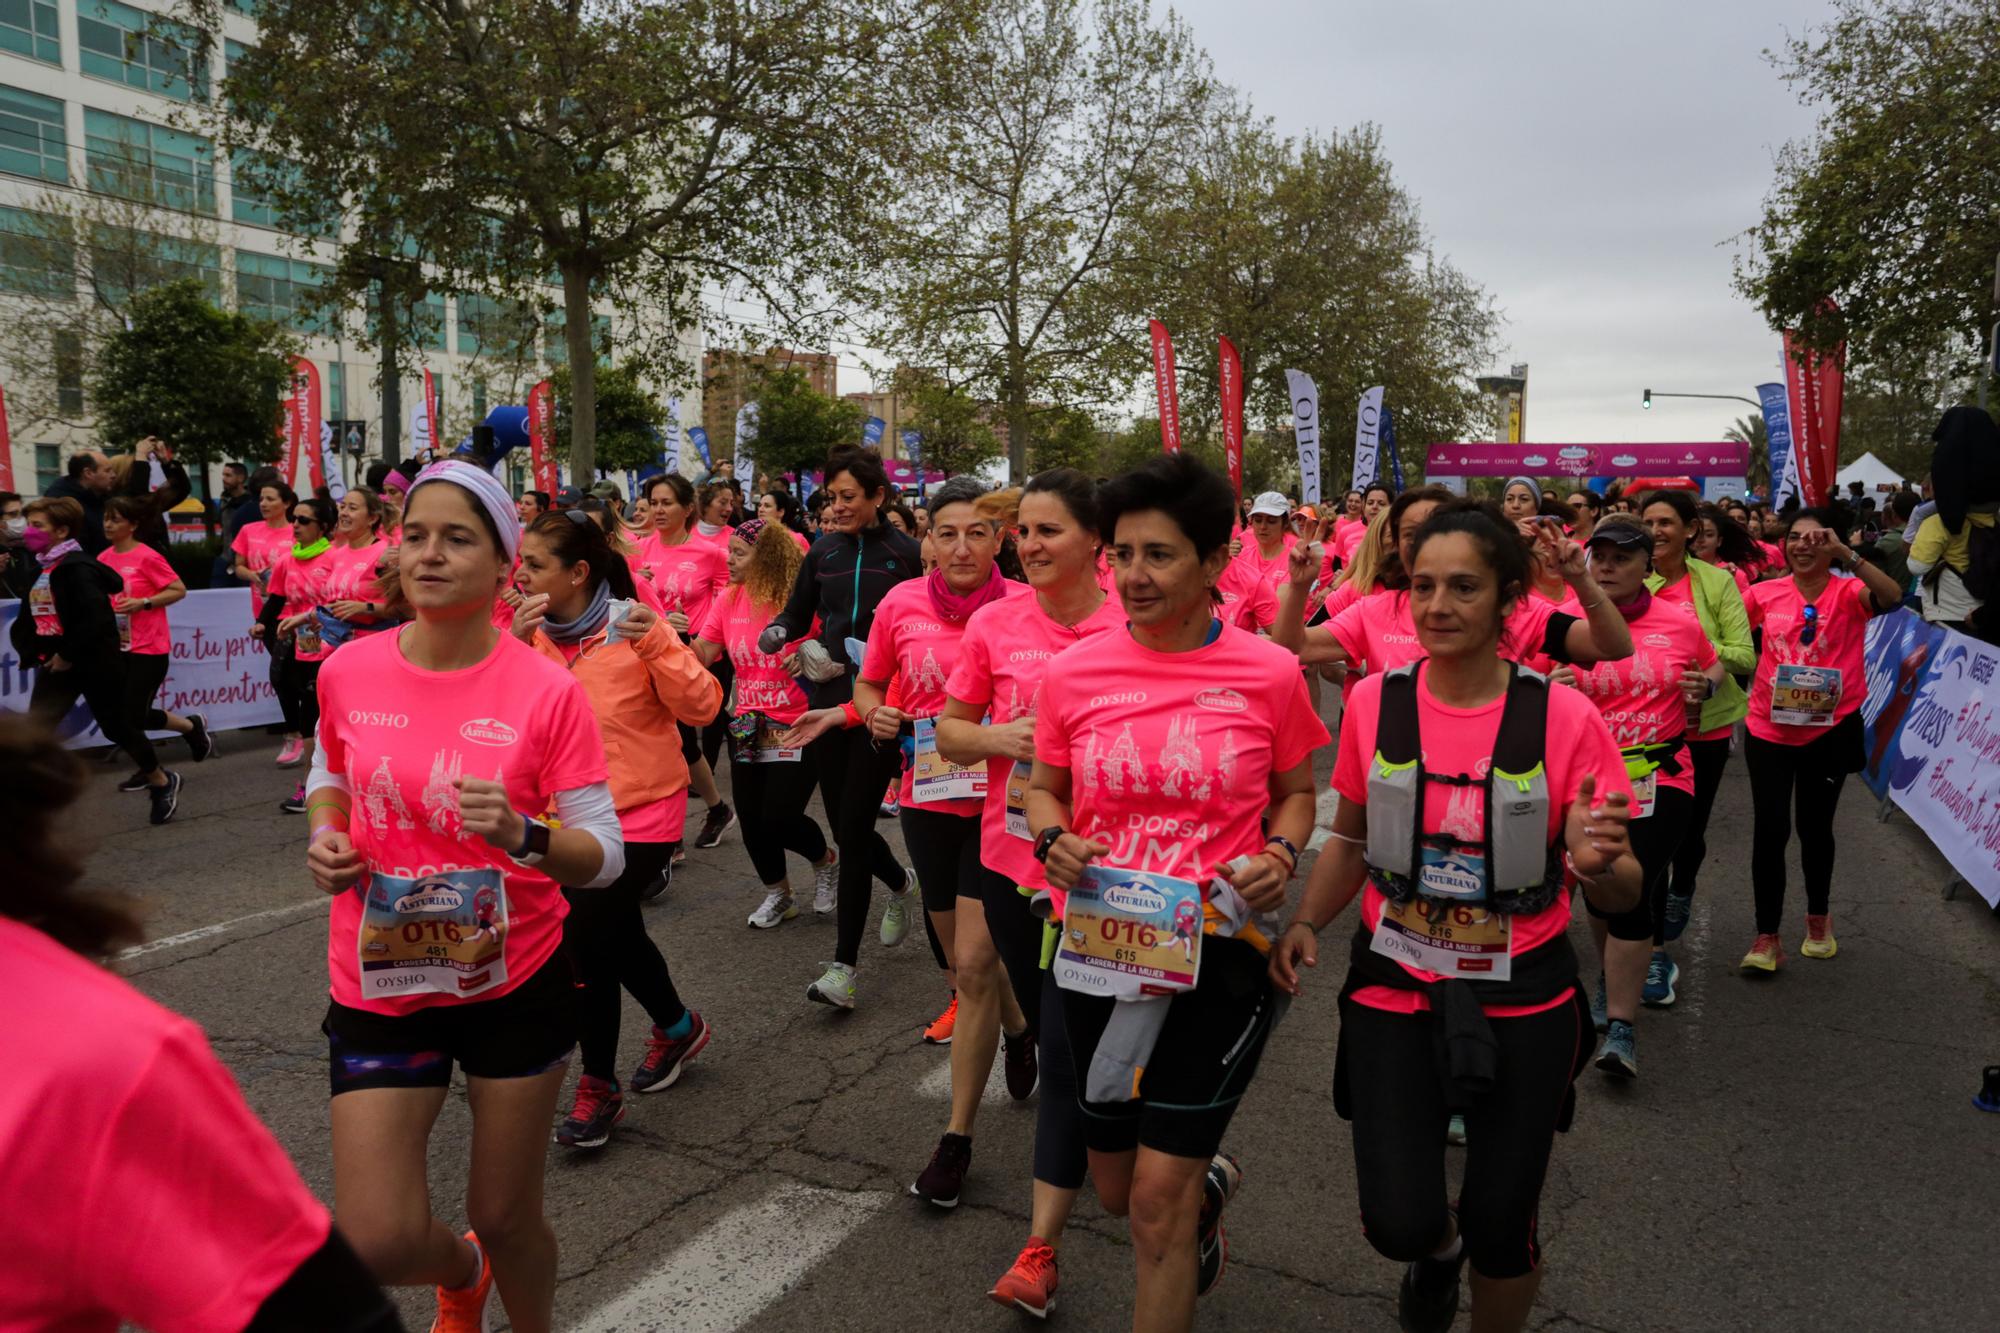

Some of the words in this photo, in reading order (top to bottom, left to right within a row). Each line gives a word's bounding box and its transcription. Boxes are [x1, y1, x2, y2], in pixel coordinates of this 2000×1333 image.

[902, 623, 942, 633] OYSHO
[192, 627, 222, 660] tu
[1010, 650, 1054, 663] OYSHO
[748, 679, 790, 690] DORSAL
[738, 688, 791, 706] SUMA
[1090, 690, 1147, 709] OYSHO
[1791, 688, 1820, 701] 016
[348, 710, 409, 729] OYSHO
[463, 725, 514, 742] ASTURIANA
[920, 786, 948, 797] OYSHO
[1423, 868, 1477, 890] ASTURIANA
[399, 897, 460, 912] ASTURIANA
[1107, 890, 1162, 909] ASTURIANA
[402, 920, 461, 943] 016
[1101, 917, 1157, 949] 016
[1429, 925, 1453, 939] 616
[426, 946, 448, 957] 481
[1384, 936, 1422, 960] OYSHO
[1431, 938, 1441, 947] DE
[1443, 940, 1454, 949] LA
[1455, 943, 1482, 953] MUJER
[1115, 948, 1137, 962] 615
[393, 957, 431, 968] CARRERA
[432, 958, 443, 966] DE
[444, 959, 453, 967] LA
[453, 961, 477, 972] MUJER
[1085, 956, 1117, 970] CARRERA
[1117, 963, 1127, 971] DE
[1127, 964, 1137, 973] LA
[1138, 967, 1165, 979] MUJER
[376, 973, 426, 988] OYSHO
[1063, 968, 1108, 987] OYSHO
